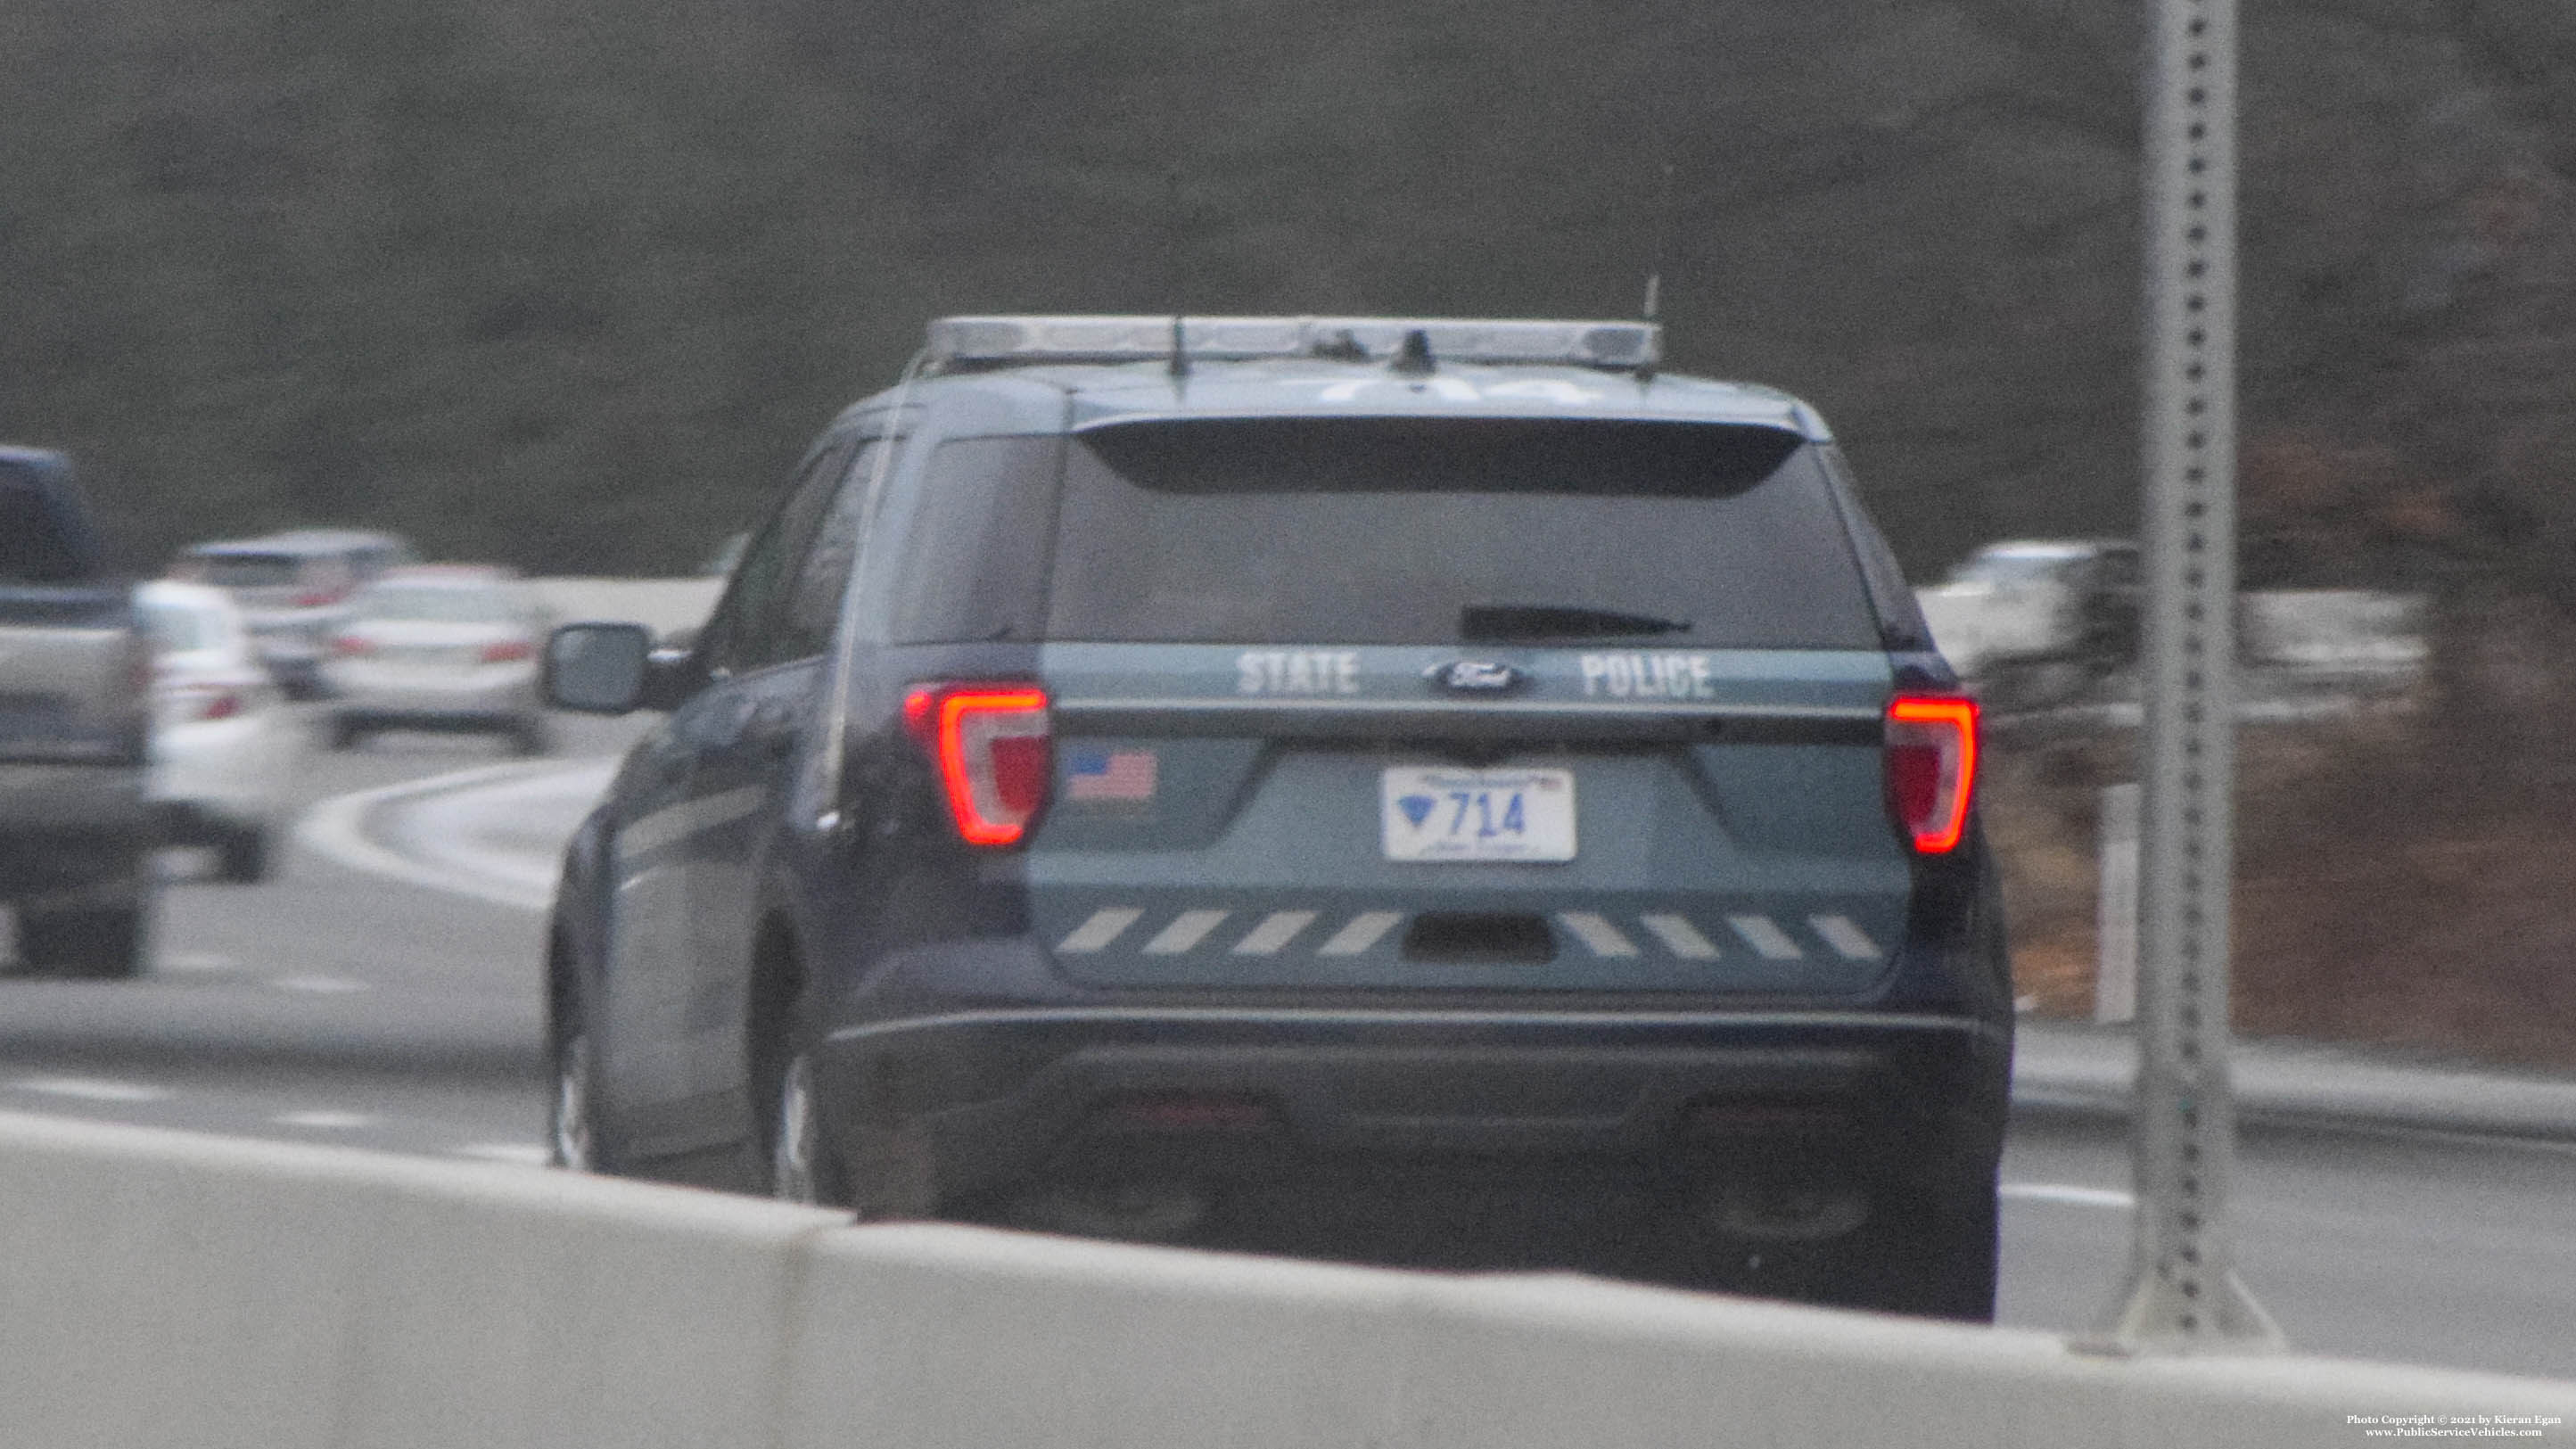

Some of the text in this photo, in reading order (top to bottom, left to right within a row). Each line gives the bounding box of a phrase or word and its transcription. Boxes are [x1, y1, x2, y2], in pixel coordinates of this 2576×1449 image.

[1237, 651, 1714, 698] STATE POLICE
[1449, 792, 1526, 836] 714
